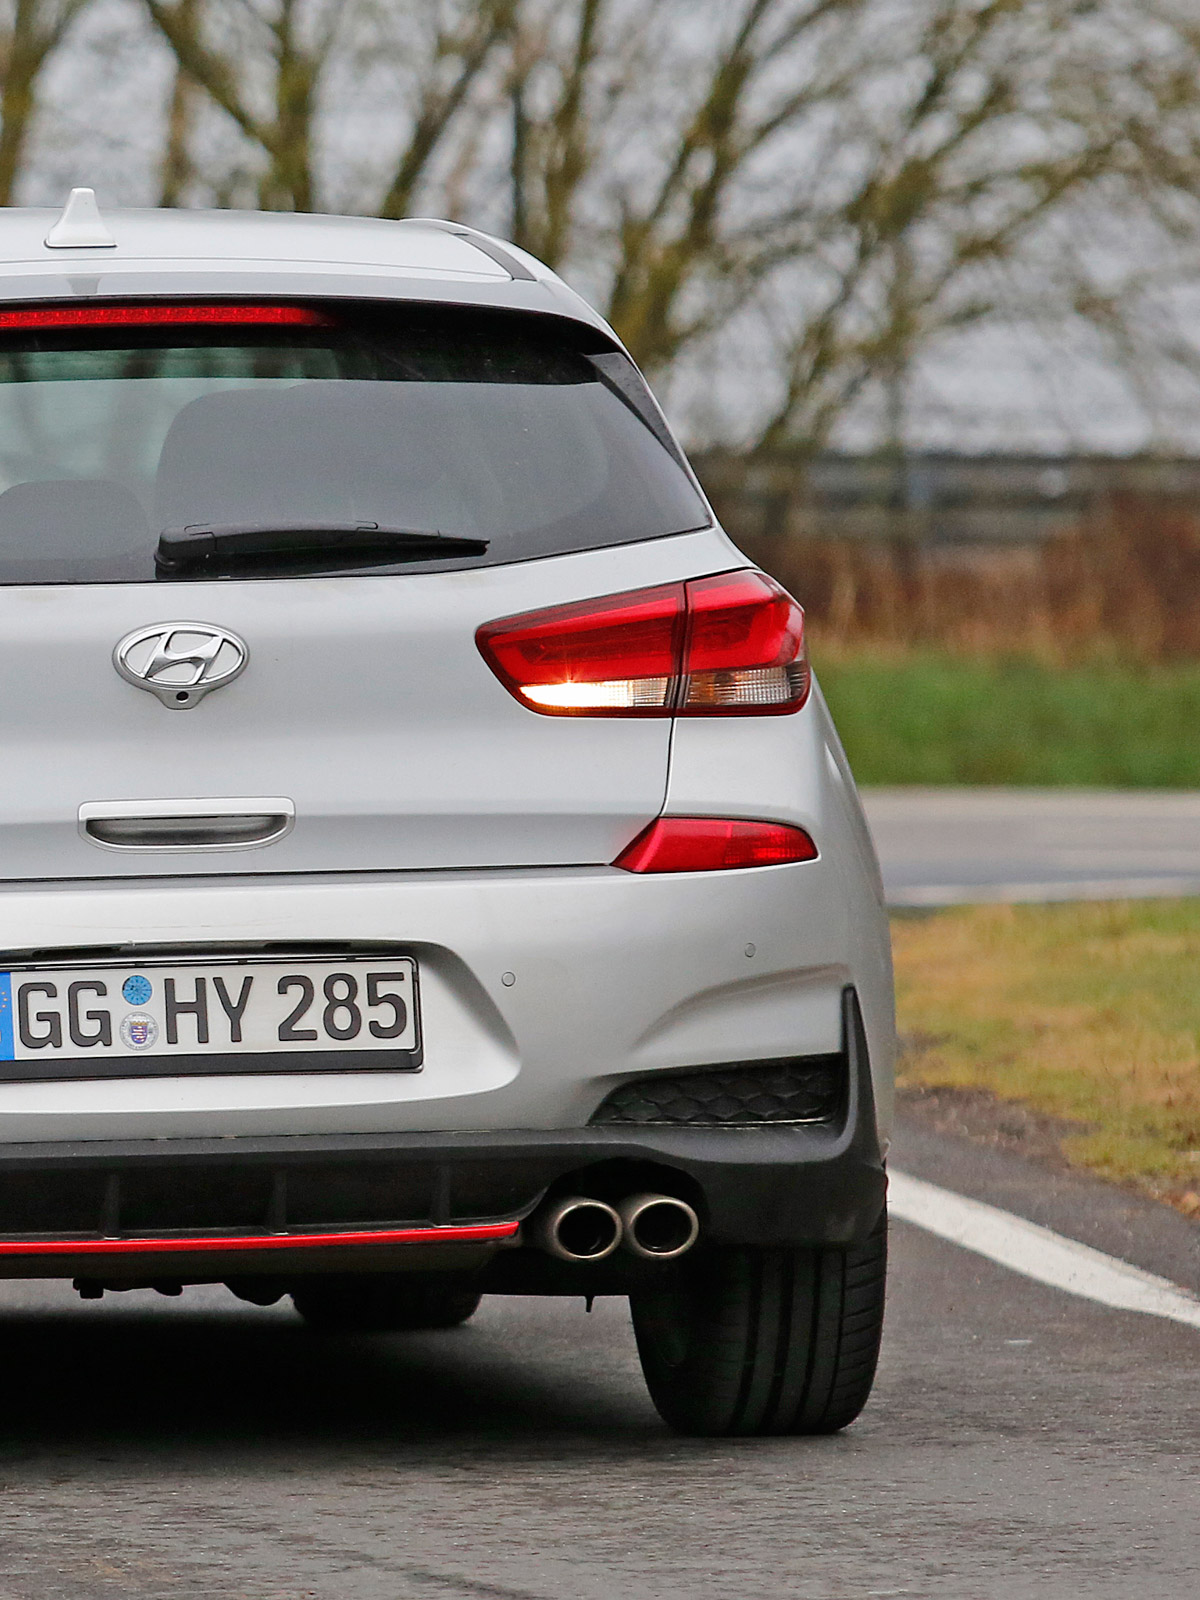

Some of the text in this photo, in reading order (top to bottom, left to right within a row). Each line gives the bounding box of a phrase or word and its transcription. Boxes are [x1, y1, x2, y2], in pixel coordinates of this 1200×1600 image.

[17, 980, 113, 1050] GG
[163, 975, 255, 1045] HY
[277, 972, 408, 1042] 285
